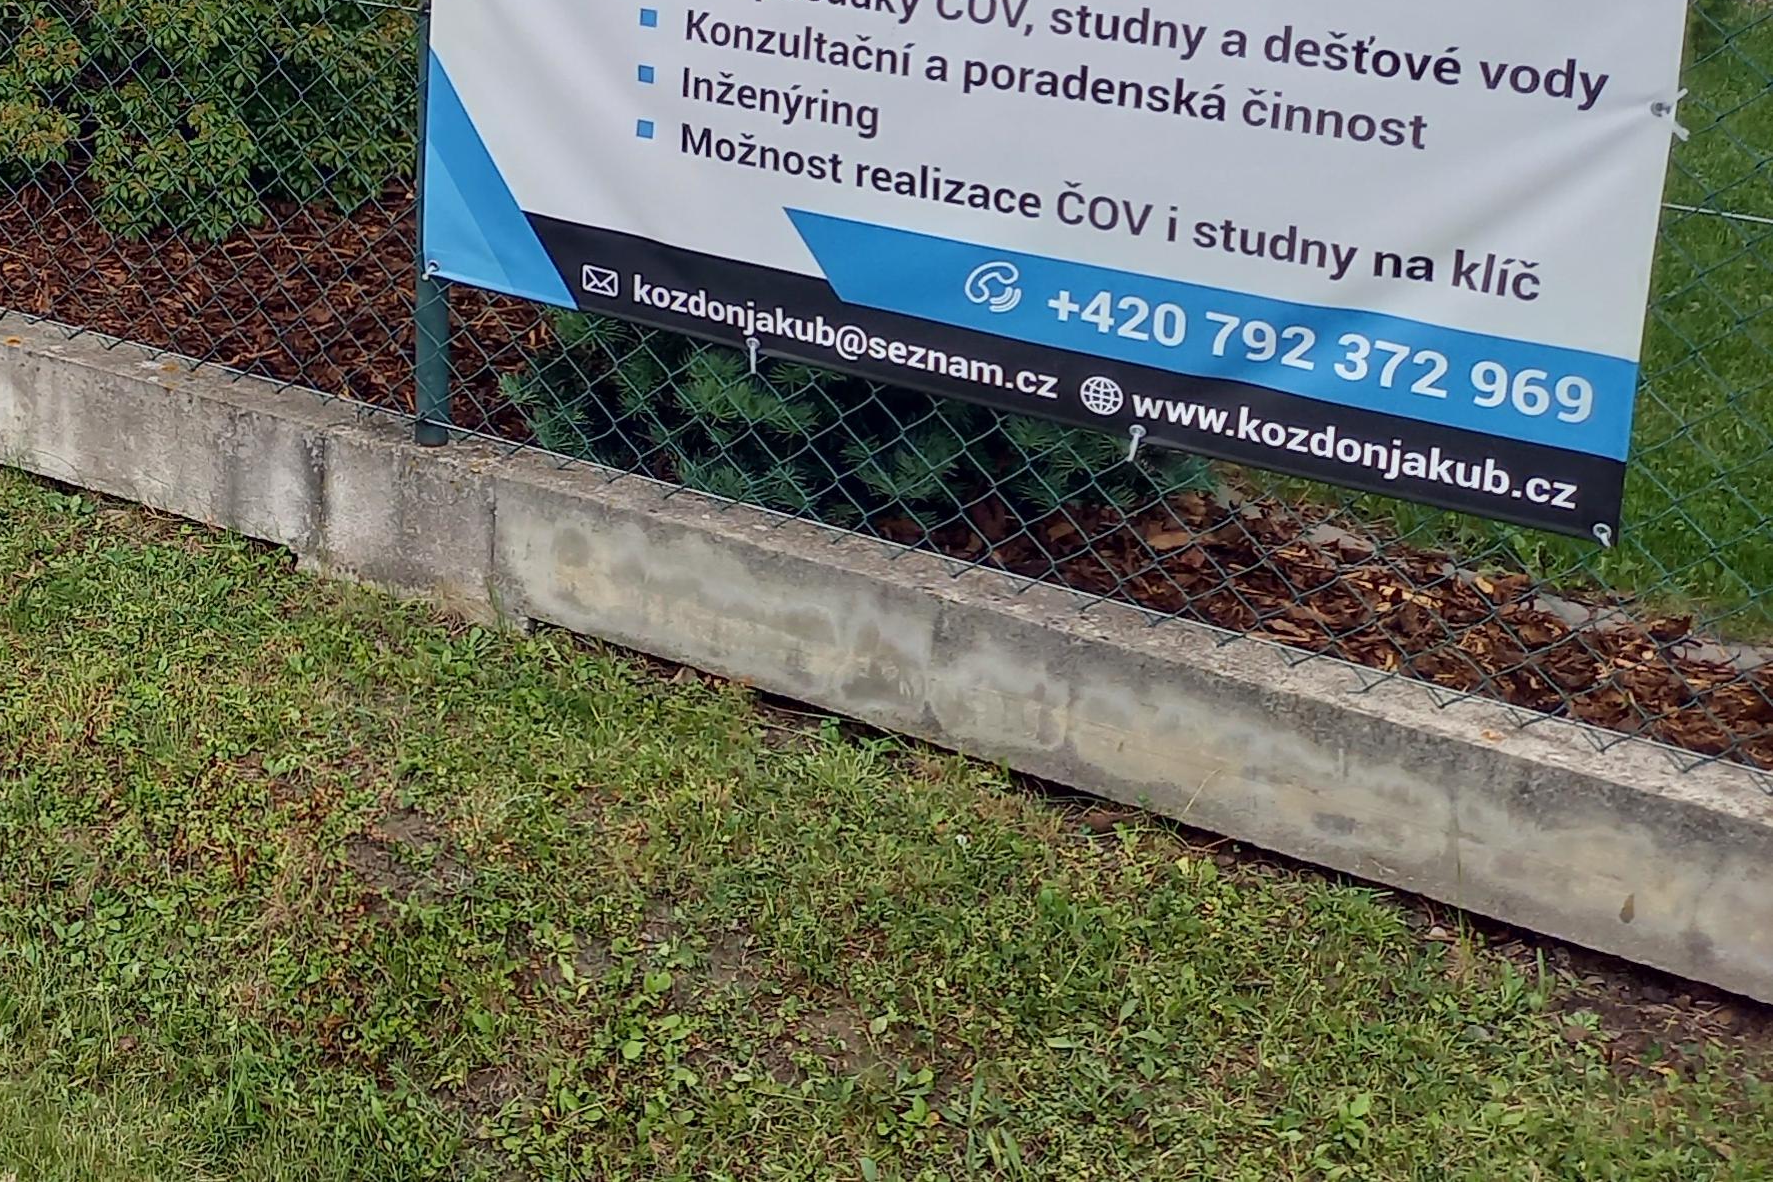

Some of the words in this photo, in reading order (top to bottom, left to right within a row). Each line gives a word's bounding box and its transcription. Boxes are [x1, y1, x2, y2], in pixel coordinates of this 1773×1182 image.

[682, 67, 879, 139] Inženýring
[685, 9, 915, 77] Konzultační
[925, 55, 948, 82] a
[963, 59, 1226, 121] poradenská
[1242, 88, 1428, 150] činnost
[1050, 5, 1207, 60] studny
[1221, 29, 1247, 58] a
[1264, 25, 1461, 86] dešťové
[1479, 59, 1610, 111] vody
[681, 123, 842, 183] Možnost
[855, 159, 1042, 219] realizace
[1056, 181, 1153, 236] ČOV
[1166, 206, 1179, 242] i
[1192, 219, 1358, 280] studny
[1373, 249, 1435, 283] na
[1451, 248, 1541, 302] klíč
[632, 274, 1059, 400] kozdonjakub@seznam.cz
[1047, 289, 1187, 347] +420
[1205, 310, 1317, 371] 792
[1333, 333, 1448, 399] 372
[1469, 359, 1594, 424] 969
[1132, 392, 1578, 511] www.kozdonjakub.cz
